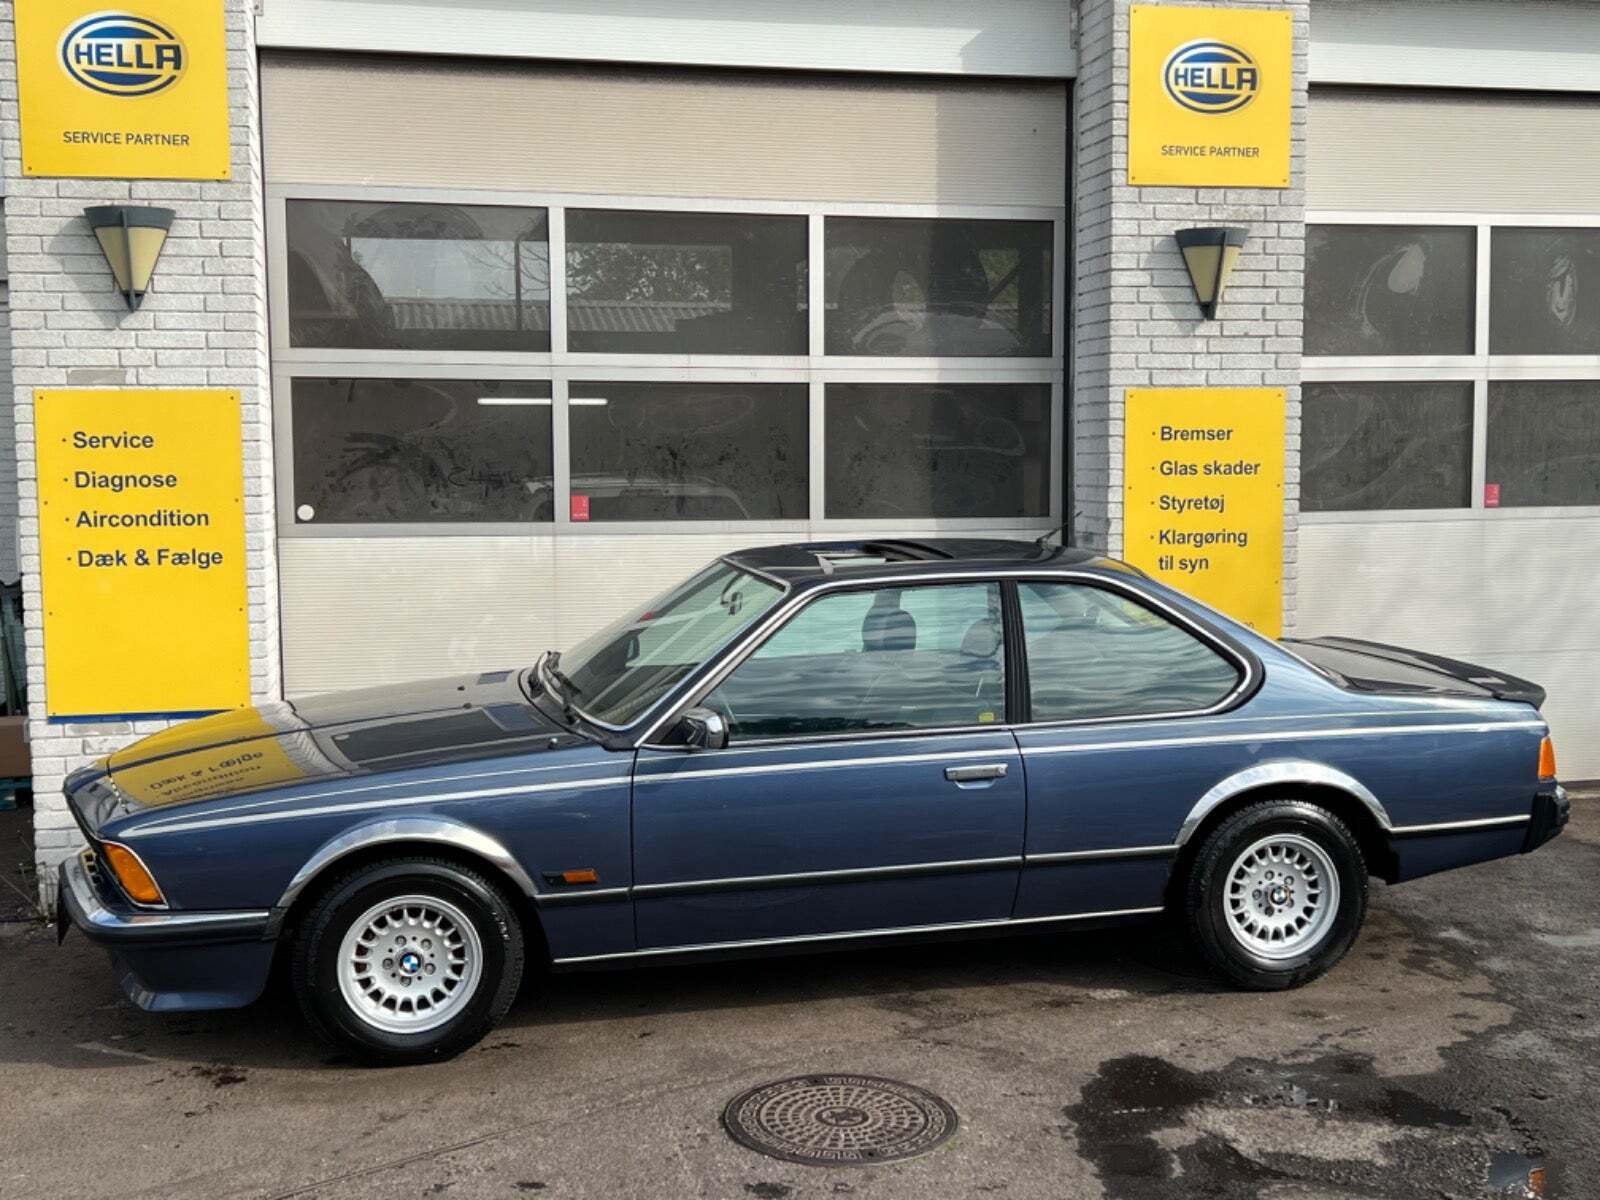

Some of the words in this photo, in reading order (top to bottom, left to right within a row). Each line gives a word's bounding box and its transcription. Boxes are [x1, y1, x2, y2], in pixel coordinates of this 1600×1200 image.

[75, 43, 182, 71] HELLA
[1174, 67, 1258, 91] HELLA
[63, 131, 121, 145] SERVICE
[126, 133, 190, 146] PARTNER
[1161, 145, 1206, 157] SERVICE
[1209, 146, 1260, 158] PARTNER
[72, 431, 154, 449] Service
[1160, 426, 1233, 442] Bremser
[1159, 460, 1198, 477] Glas
[1203, 460, 1261, 477] skader
[74, 471, 178, 492] Diagnose
[1159, 494, 1225, 515] Styretøj
[76, 509, 209, 528] Aircondition
[1159, 529, 1248, 549] Klargøring
[78, 549, 128, 567] Dæk
[134, 549, 150, 566] &
[157, 548, 223, 570] Fælge
[1158, 555, 1174, 571] til
[1179, 558, 1209, 575] syn
